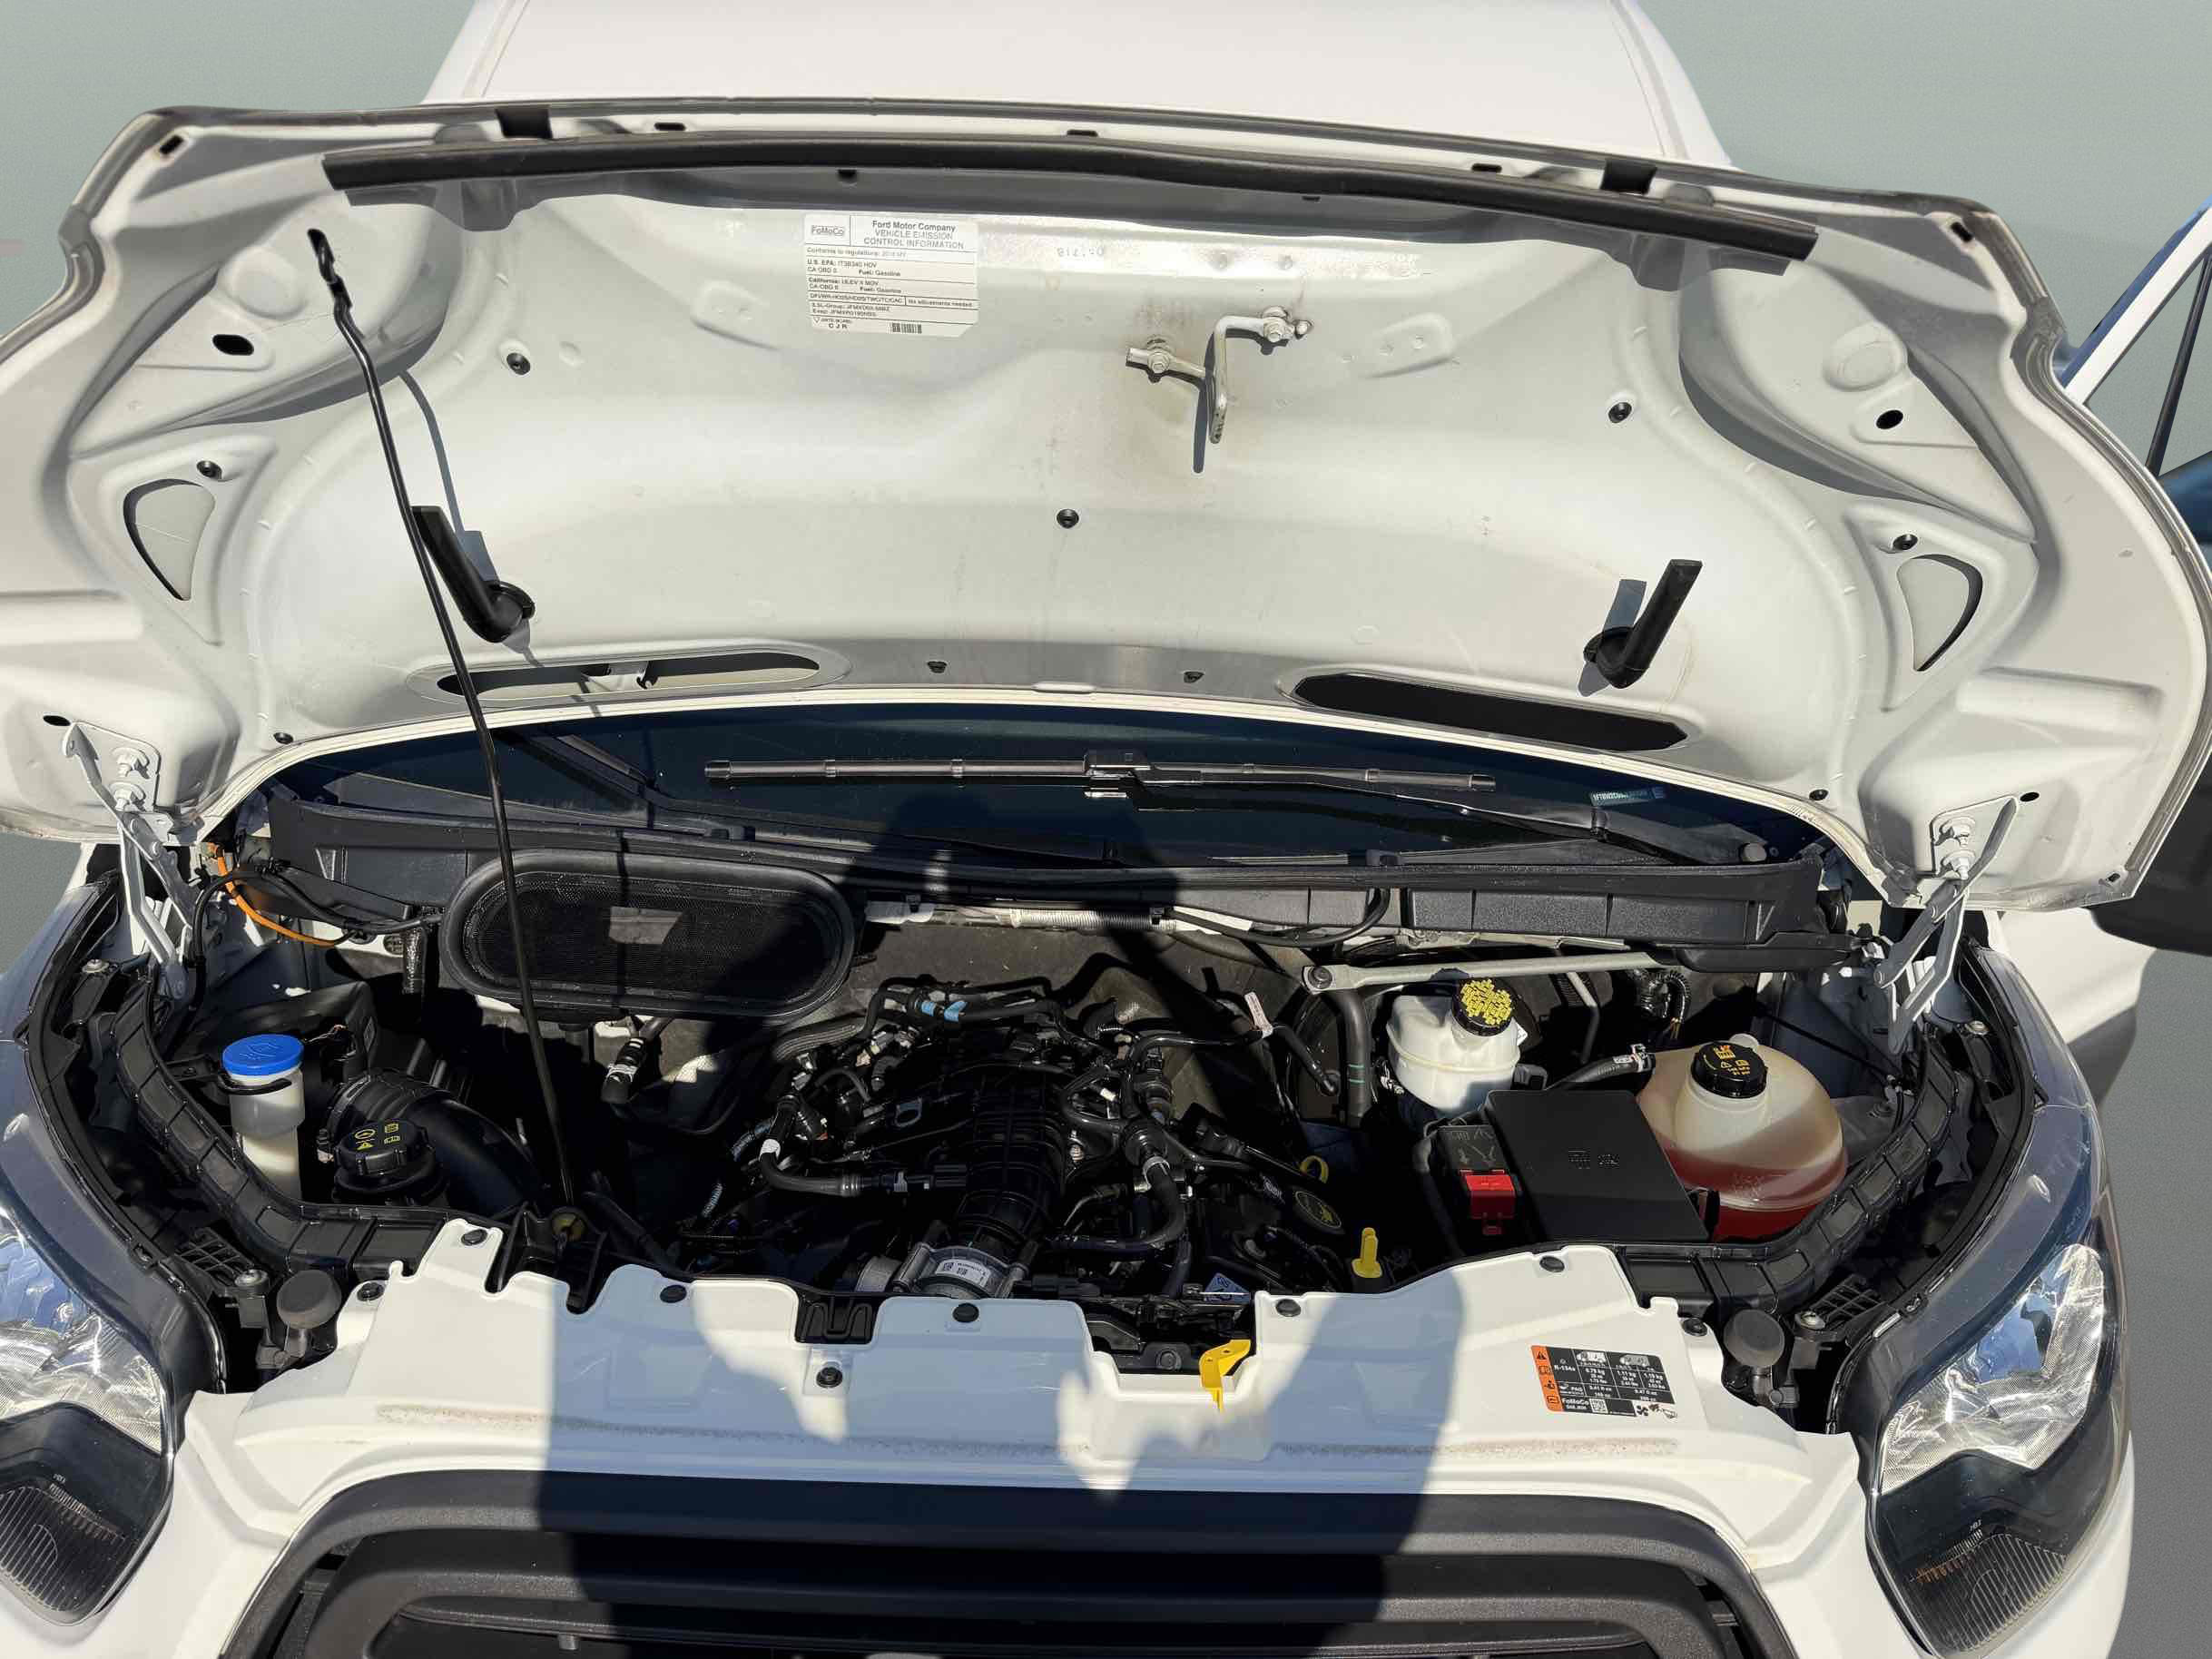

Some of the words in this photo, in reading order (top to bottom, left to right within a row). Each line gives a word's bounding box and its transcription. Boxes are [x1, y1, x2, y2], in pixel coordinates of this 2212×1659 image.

[872, 221, 891, 229] Ford
[893, 221, 916, 231] Motor
[919, 223, 956, 232] Company
[875, 229, 911, 238] VEHICLE
[913, 231, 953, 240] EMISSION
[864, 237, 904, 247] CONTROL
[906, 240, 964, 250] INFORMATION
